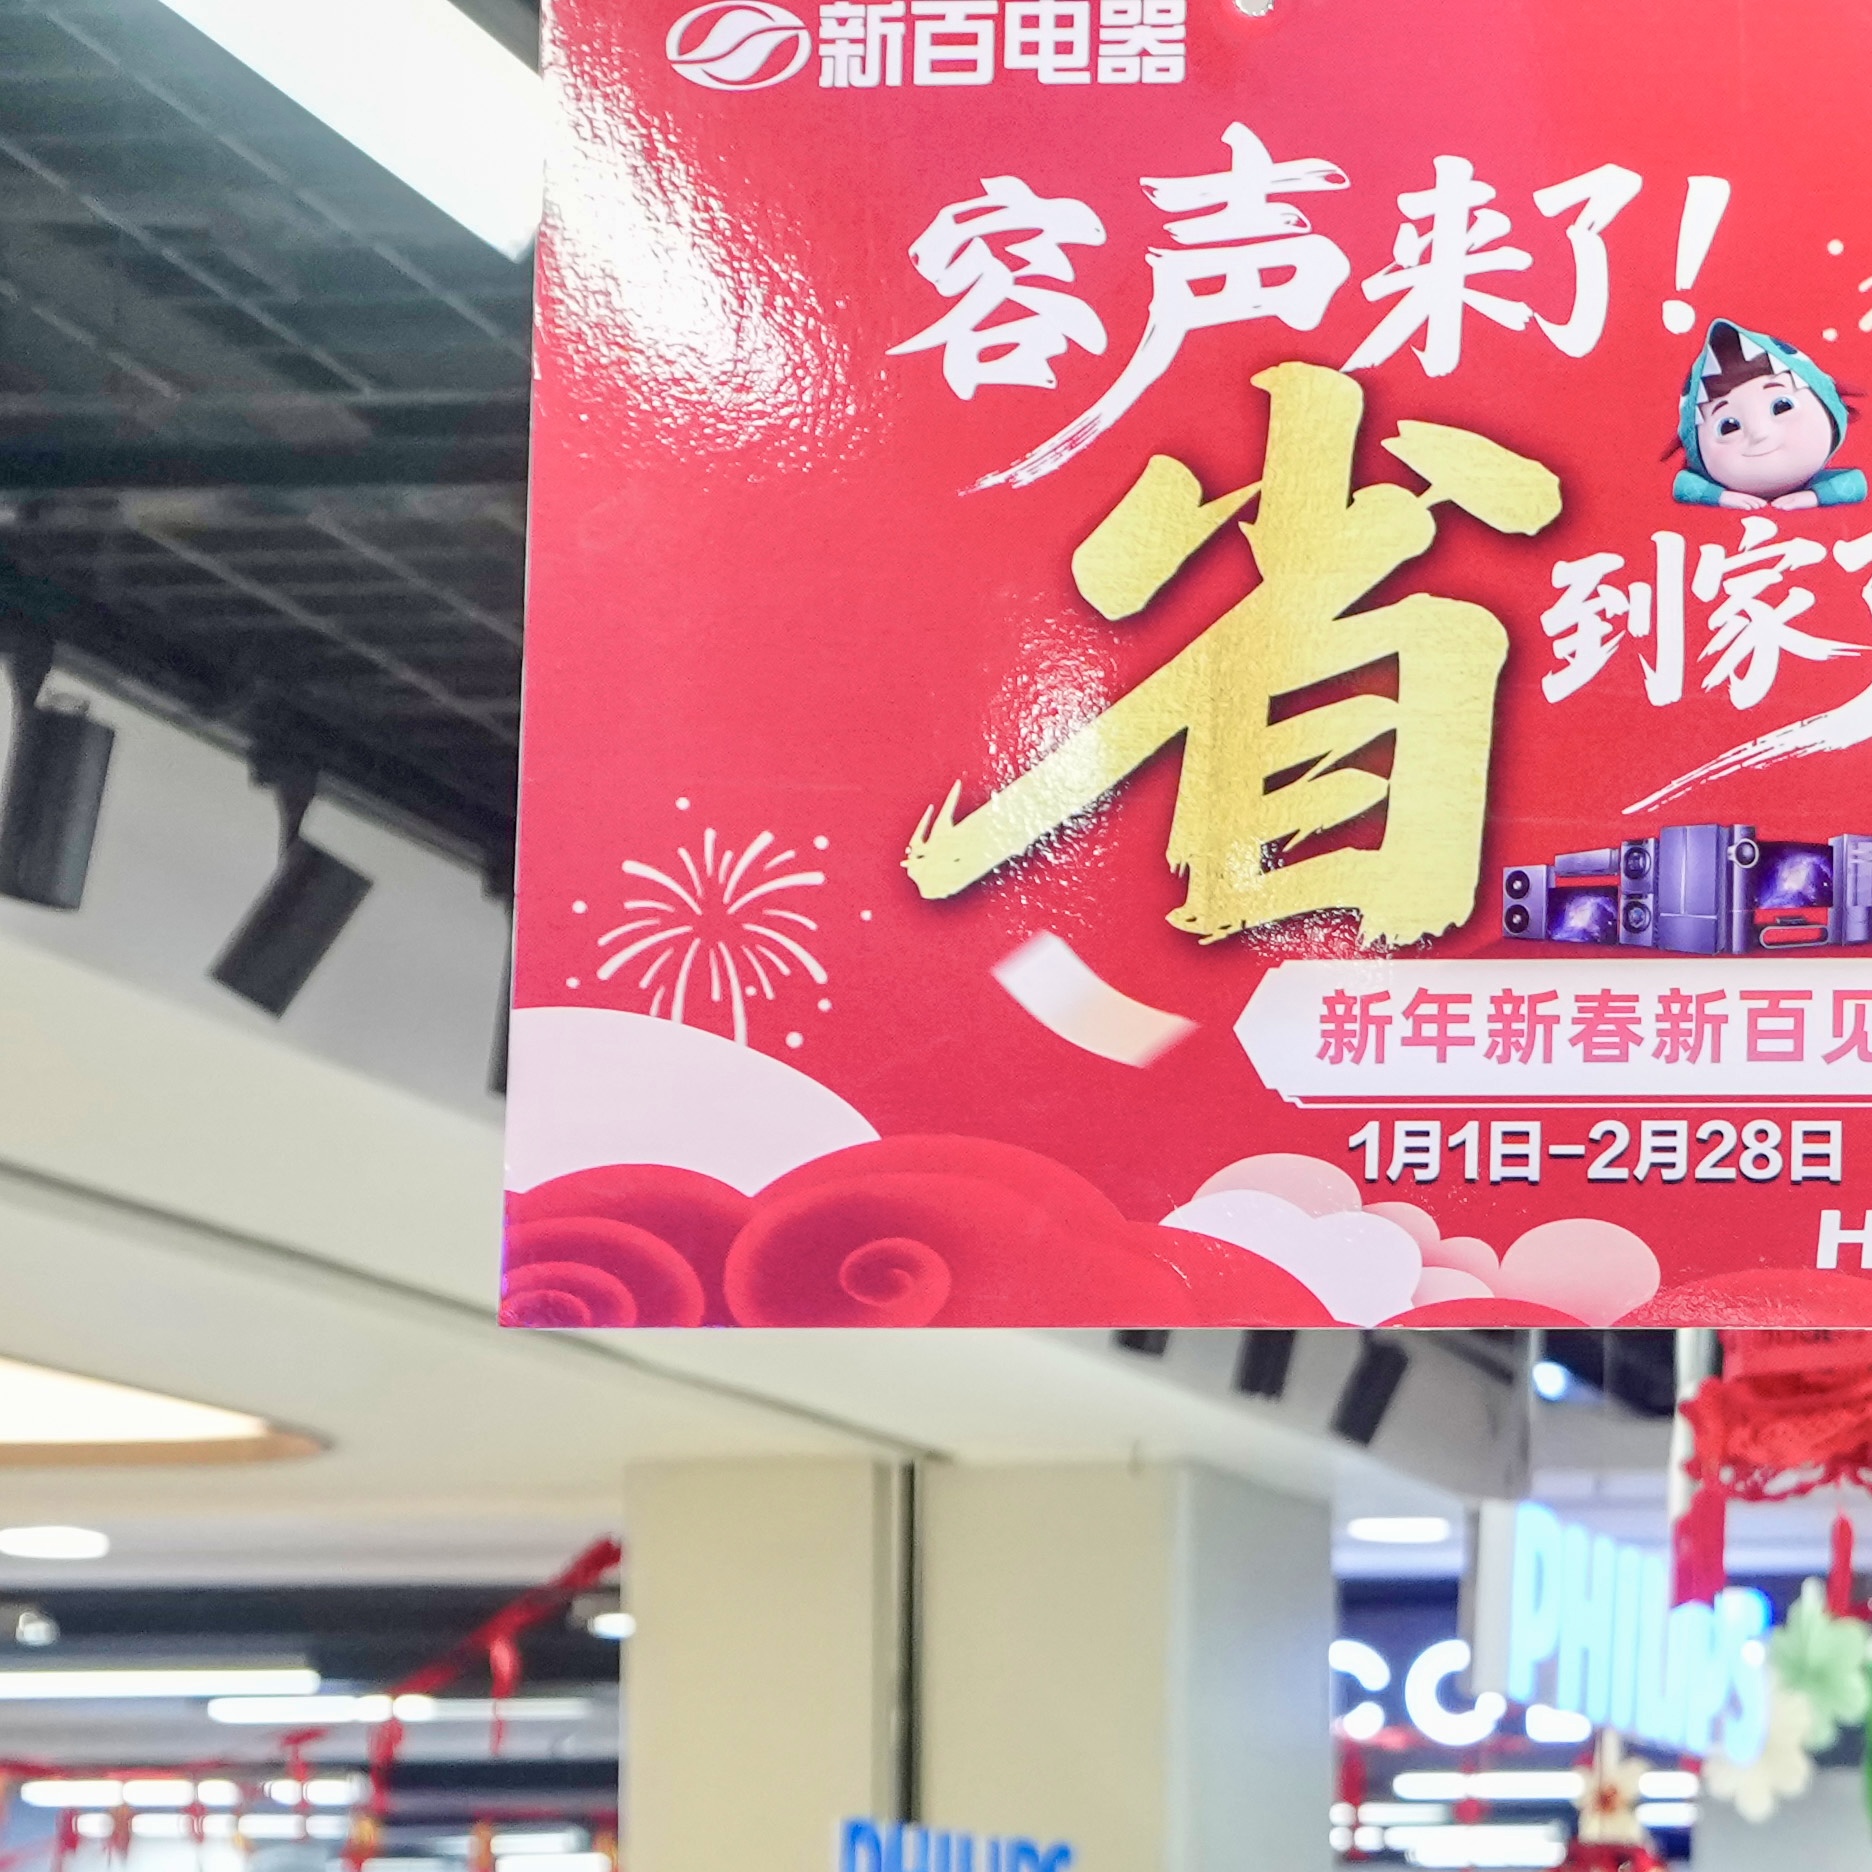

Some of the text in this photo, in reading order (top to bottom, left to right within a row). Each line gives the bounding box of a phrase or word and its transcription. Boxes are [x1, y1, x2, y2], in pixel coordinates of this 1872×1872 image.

[818, 0, 1187, 87] 新百电器
[887, 122, 1732, 496] 容声来了！
